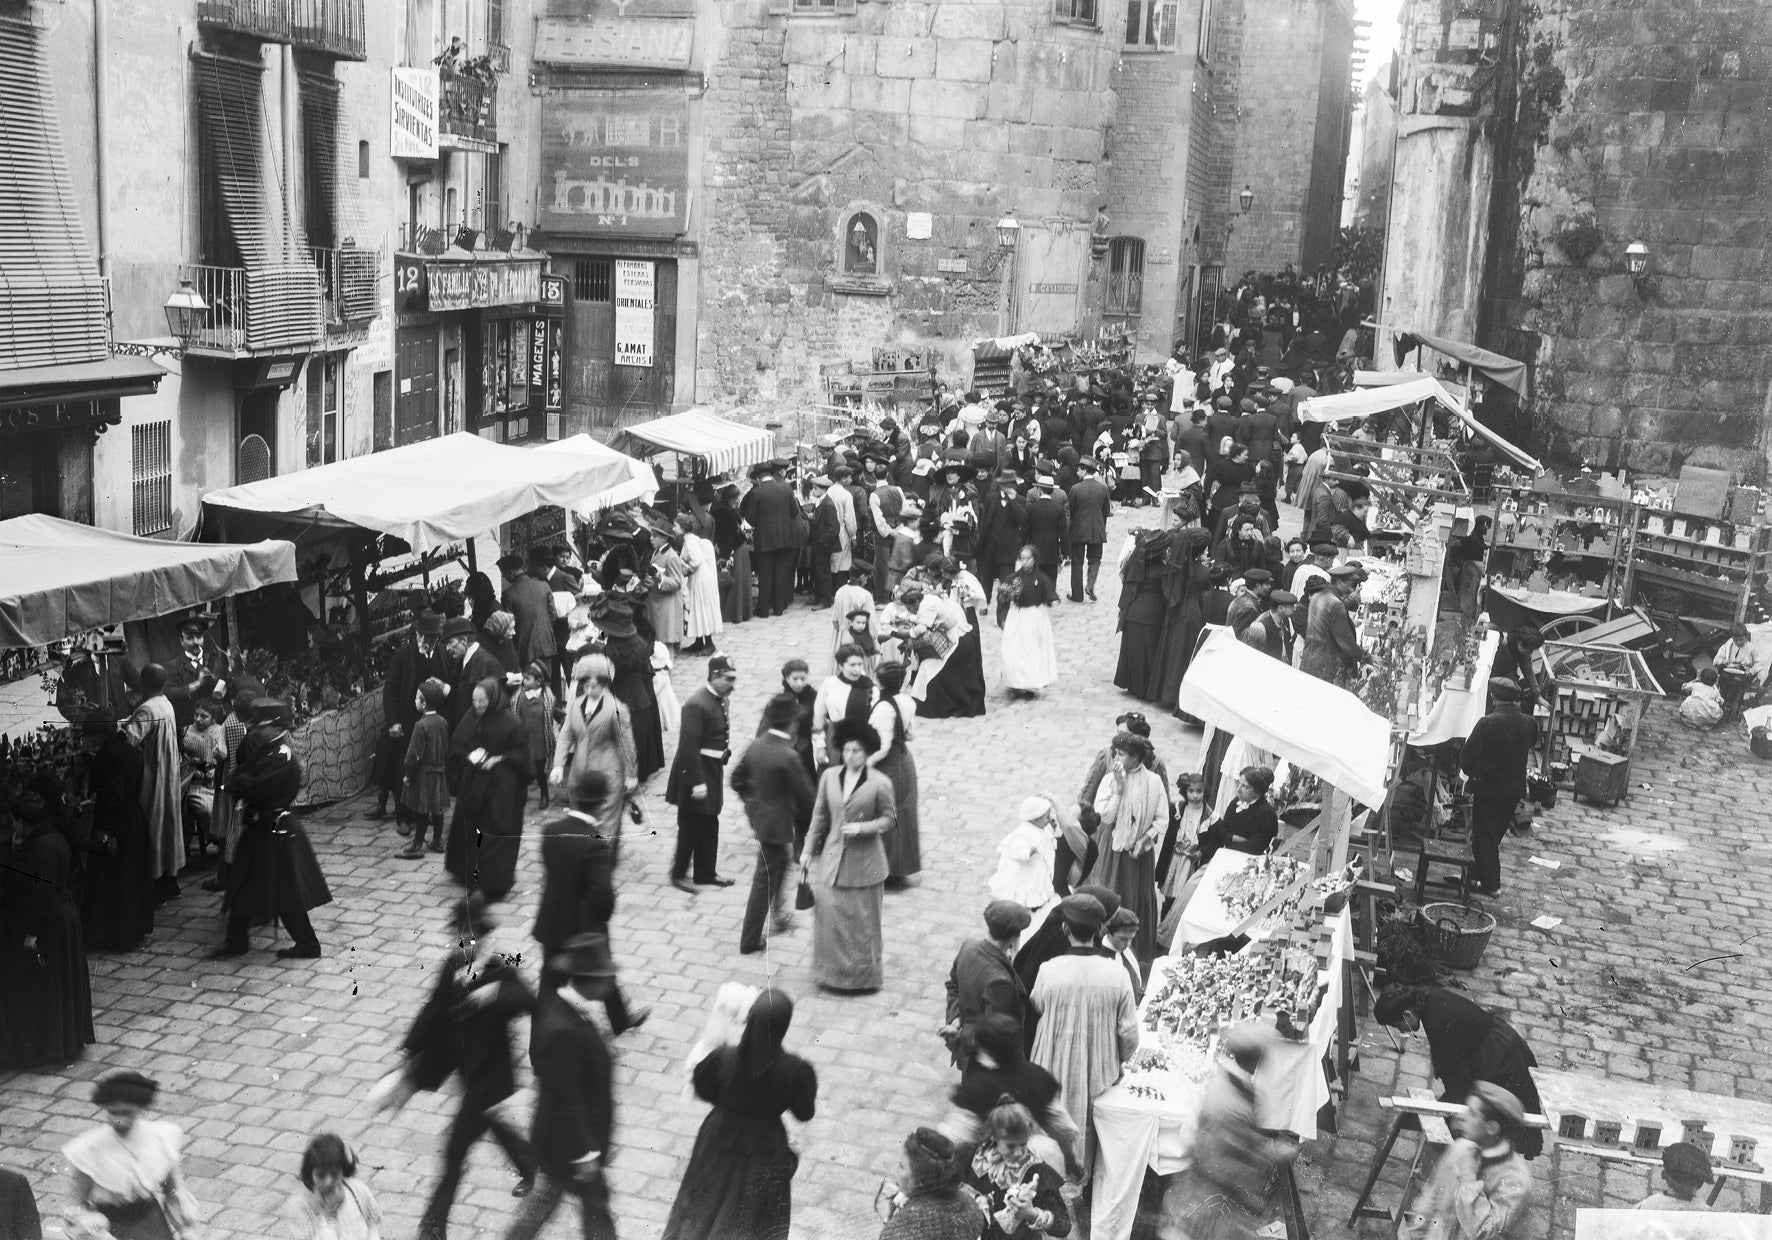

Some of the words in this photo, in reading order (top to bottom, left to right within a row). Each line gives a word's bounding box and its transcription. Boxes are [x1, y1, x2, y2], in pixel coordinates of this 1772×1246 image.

[394, 100, 433, 148] SIRVIENTAS
[590, 155, 640, 167] DELS
[617, 261, 648, 270] ALFOMBRAS
[397, 266, 420, 293] 12
[623, 270, 649, 278] ESTERAS
[624, 279, 653, 287] PERSIANAS
[616, 297, 653, 310] ORIENTALES
[532, 320, 545, 386] IMAGENES
